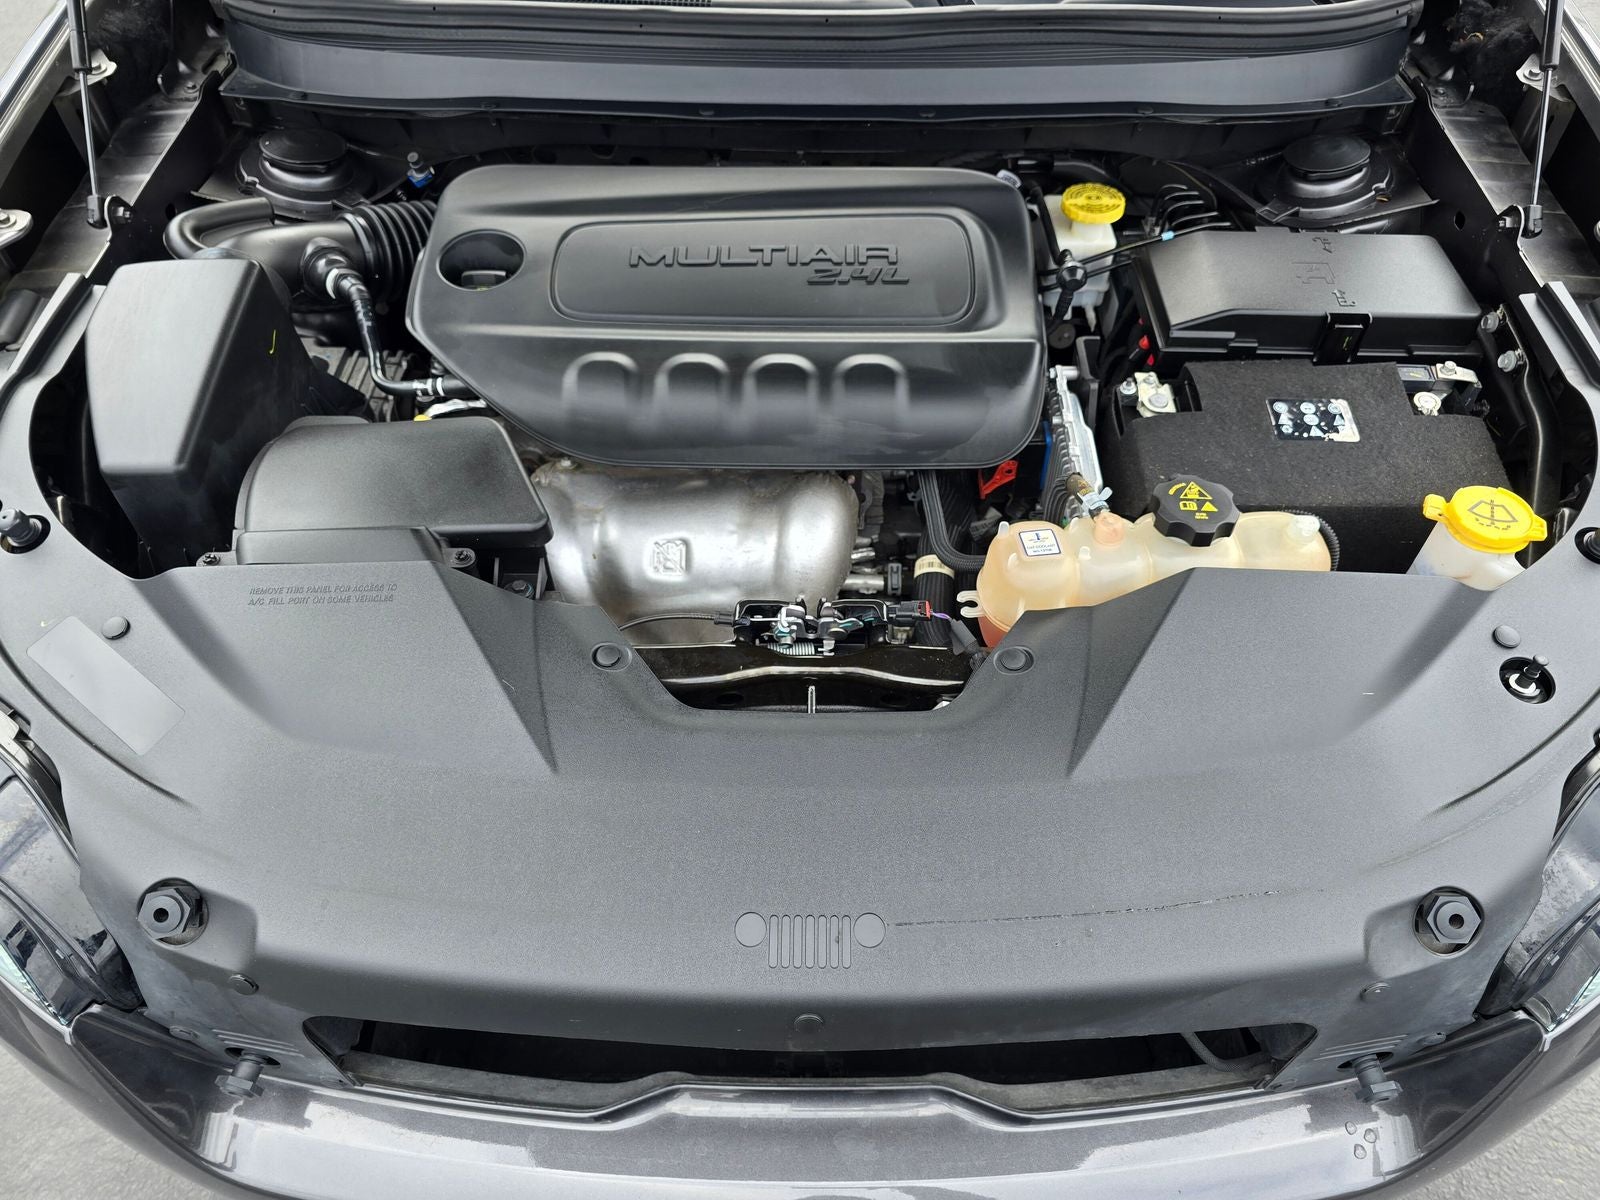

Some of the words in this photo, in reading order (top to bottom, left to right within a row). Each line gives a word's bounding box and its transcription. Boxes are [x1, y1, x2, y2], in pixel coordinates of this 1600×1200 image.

[628, 244, 898, 268] MULTIAIR
[806, 267, 910, 285] 2.4L
[249, 586, 284, 595] REMOVE
[286, 586, 304, 595] THIS
[306, 585, 332, 594] PANEL
[334, 584, 351, 594] FOR
[352, 583, 385, 593] ACCESS
[386, 583, 398, 592] TO
[248, 597, 265, 606] A/C
[268, 597, 286, 606] FILL
[288, 596, 311, 605] PORT
[312, 596, 326, 604] ON
[327, 595, 352, 604] SOME
[354, 594, 394, 603] VEHICLES
